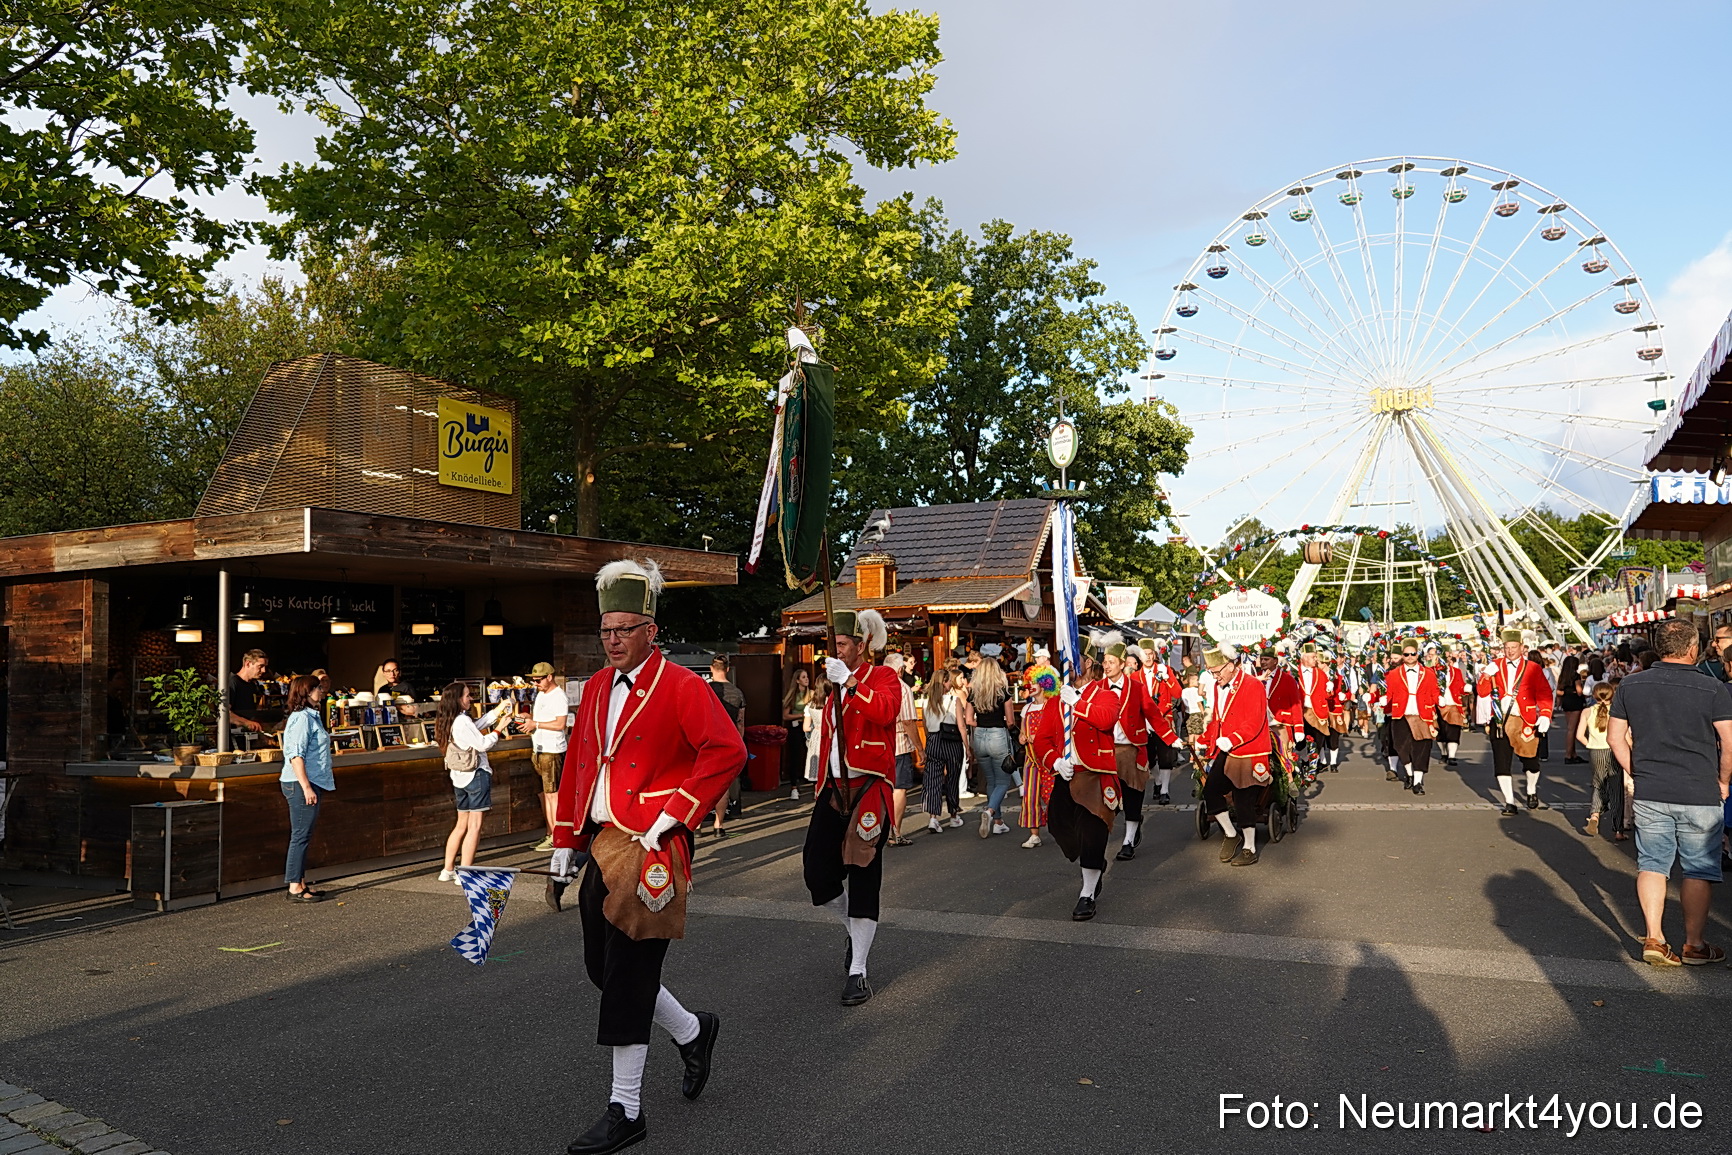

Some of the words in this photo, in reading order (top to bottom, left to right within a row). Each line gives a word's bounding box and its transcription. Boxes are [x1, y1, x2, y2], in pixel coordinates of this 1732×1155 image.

[443, 421, 508, 473] Burgis
[1220, 609, 1269, 618] Lammsbräu
[1218, 620, 1270, 631] Schäffler
